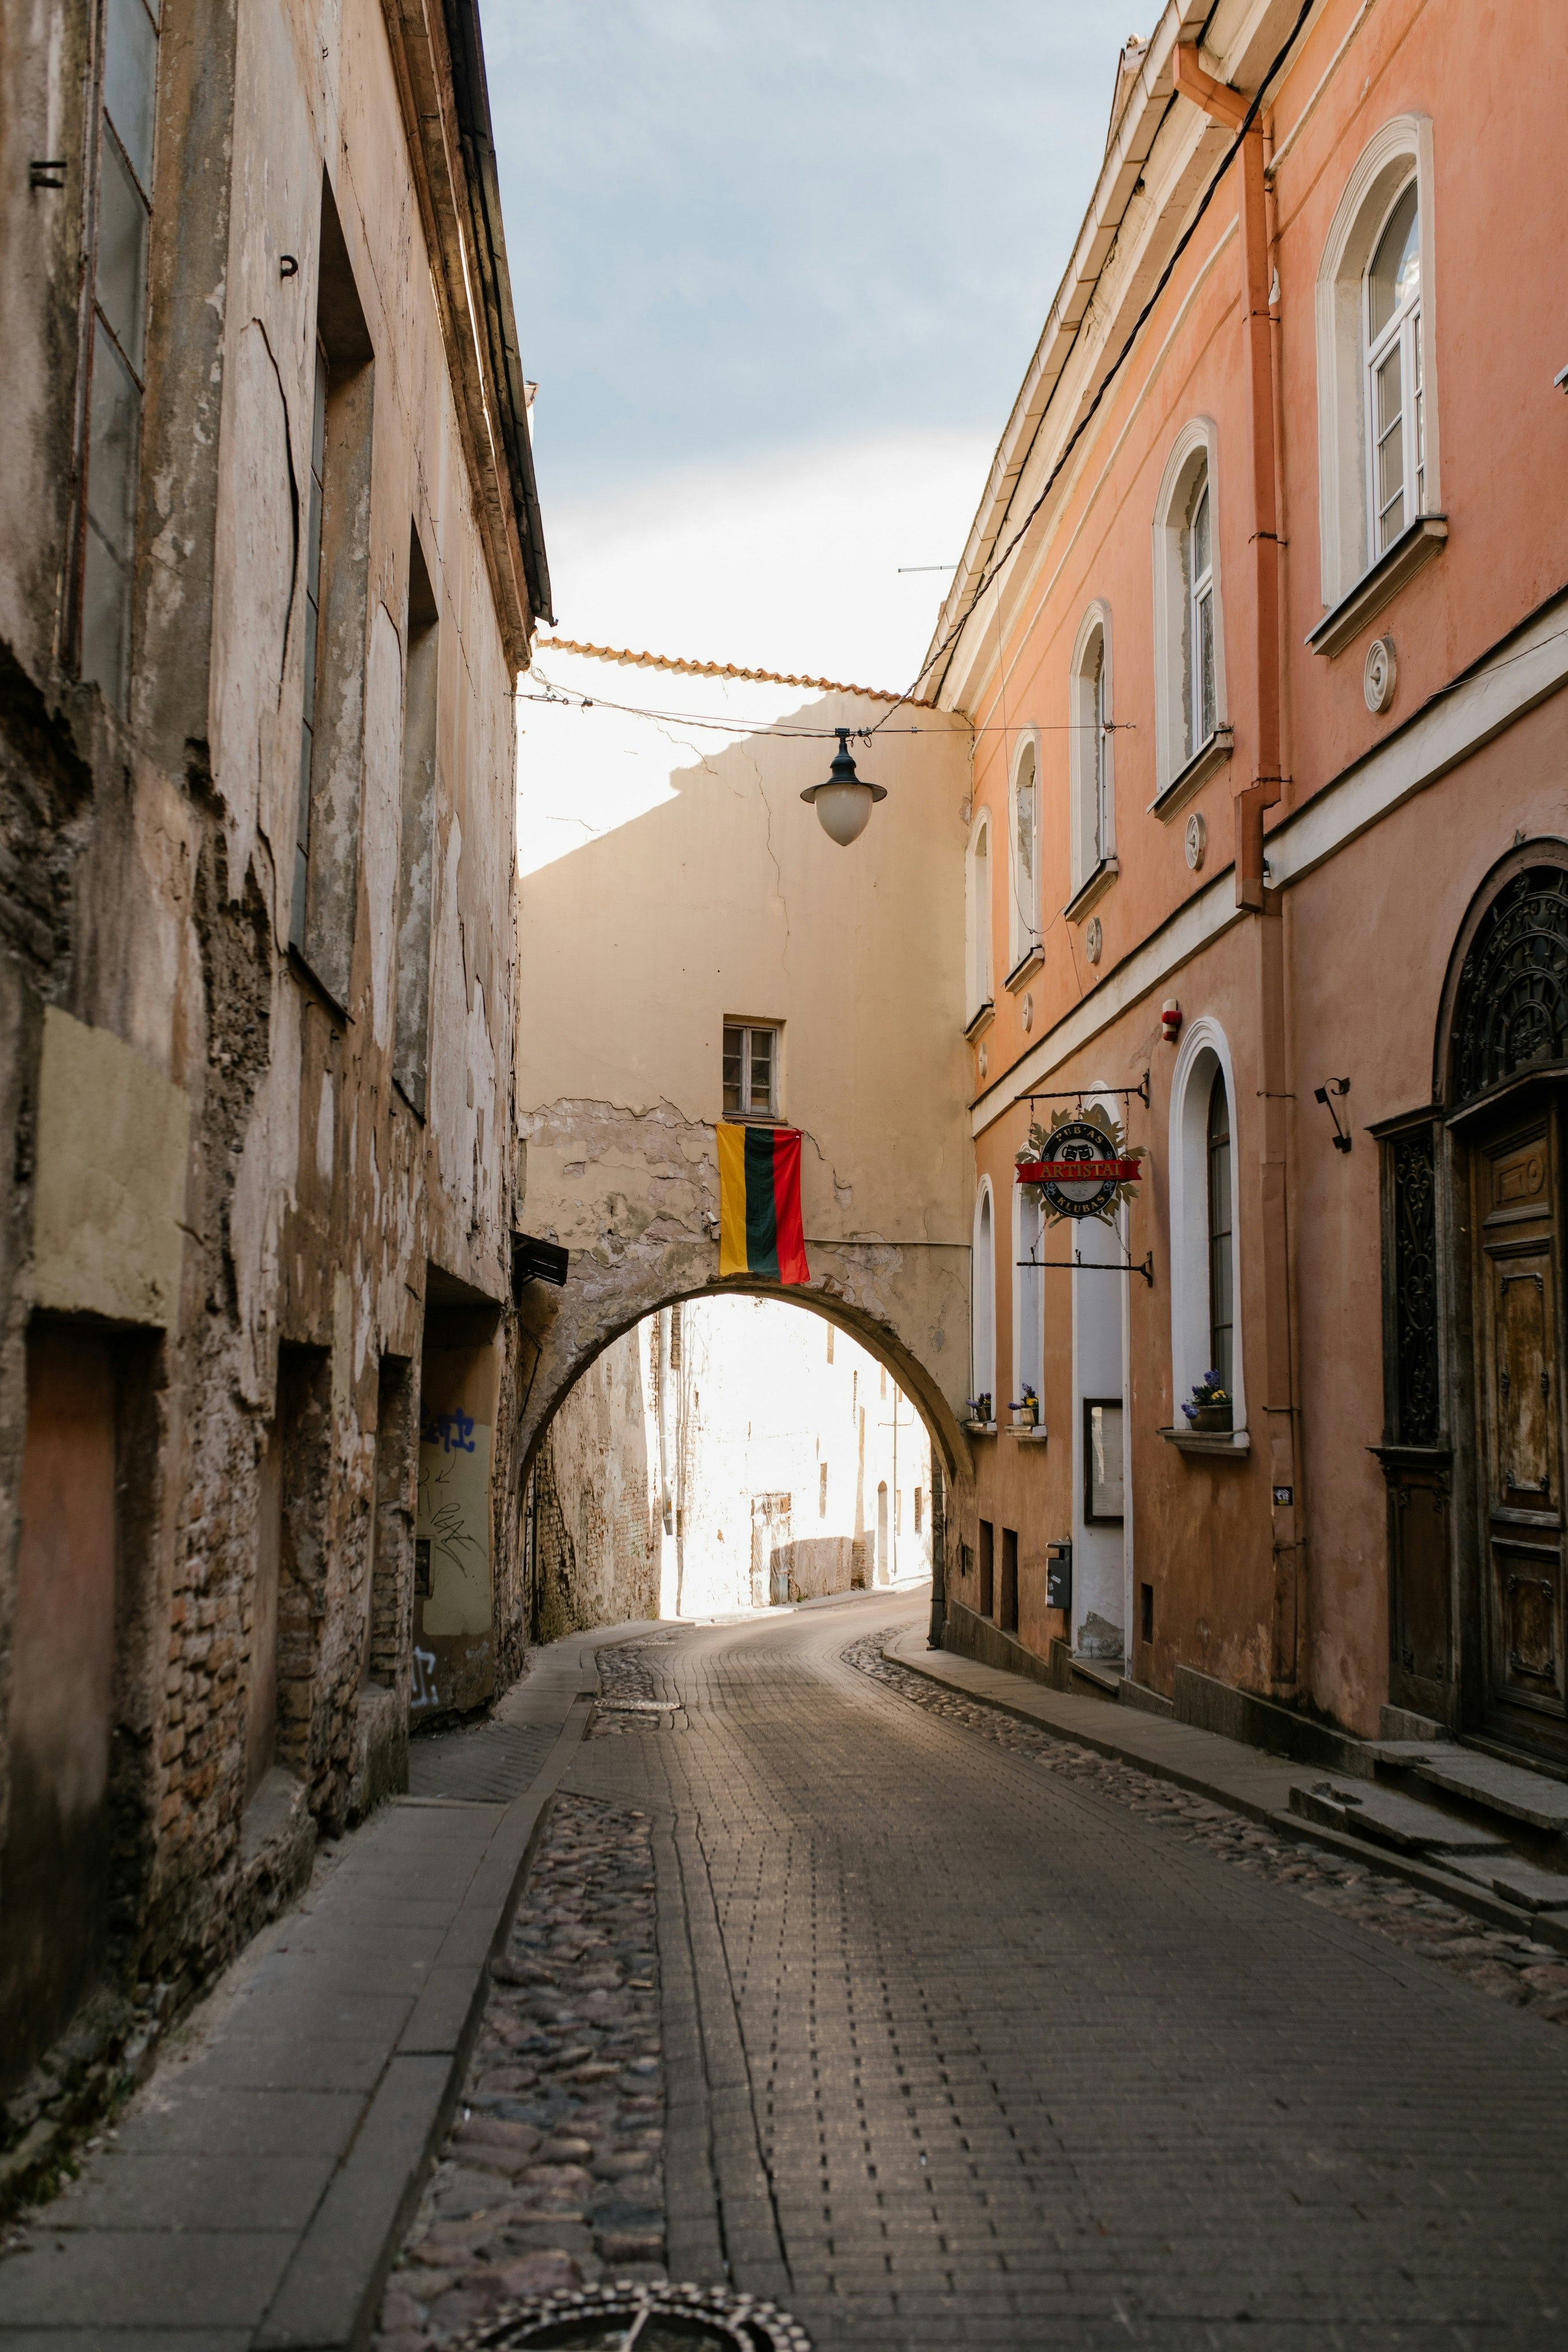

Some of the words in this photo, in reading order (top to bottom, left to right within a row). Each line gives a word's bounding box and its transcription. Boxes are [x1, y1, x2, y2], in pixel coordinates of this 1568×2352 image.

[1055, 1126, 1104, 1144] PUB'AS
[1039, 1163, 1121, 1178] ARTISTAI
[1056, 1196, 1105, 1213] KLUBAS
